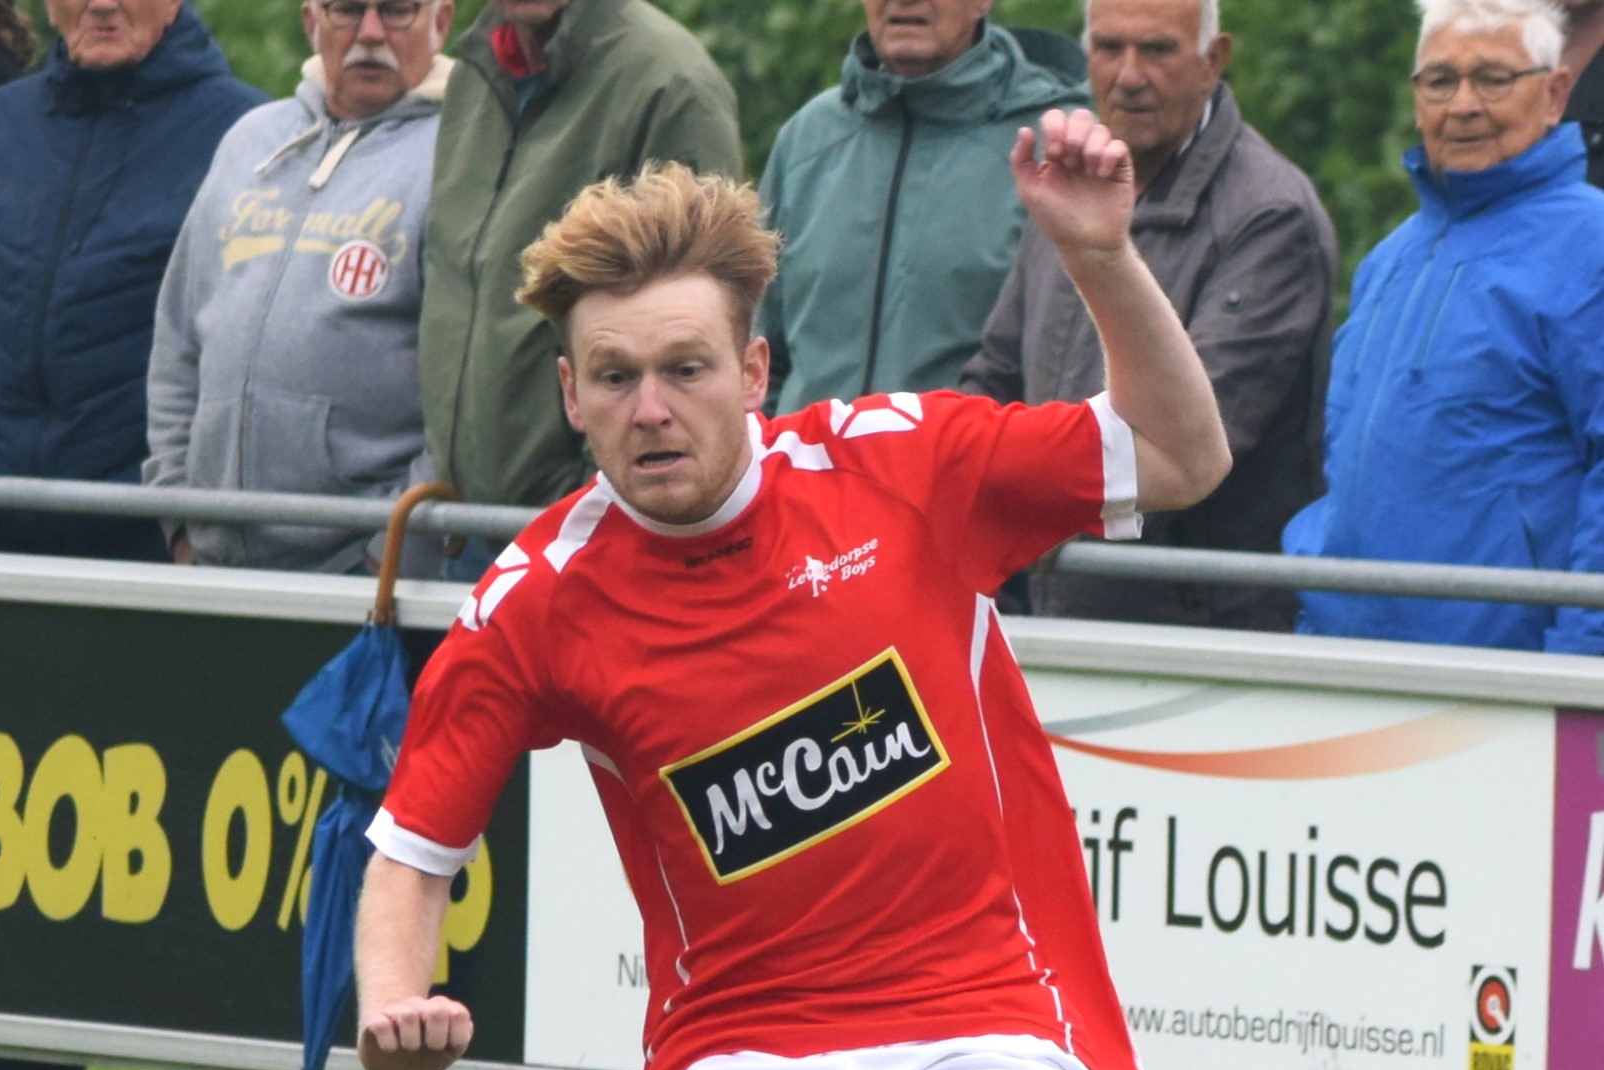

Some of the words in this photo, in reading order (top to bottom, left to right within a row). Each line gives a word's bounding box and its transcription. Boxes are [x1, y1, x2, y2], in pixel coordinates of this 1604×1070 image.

[840, 555, 877, 582] Boys
[706, 721, 932, 855] McCain
[1165, 815, 1448, 949] Louisse
